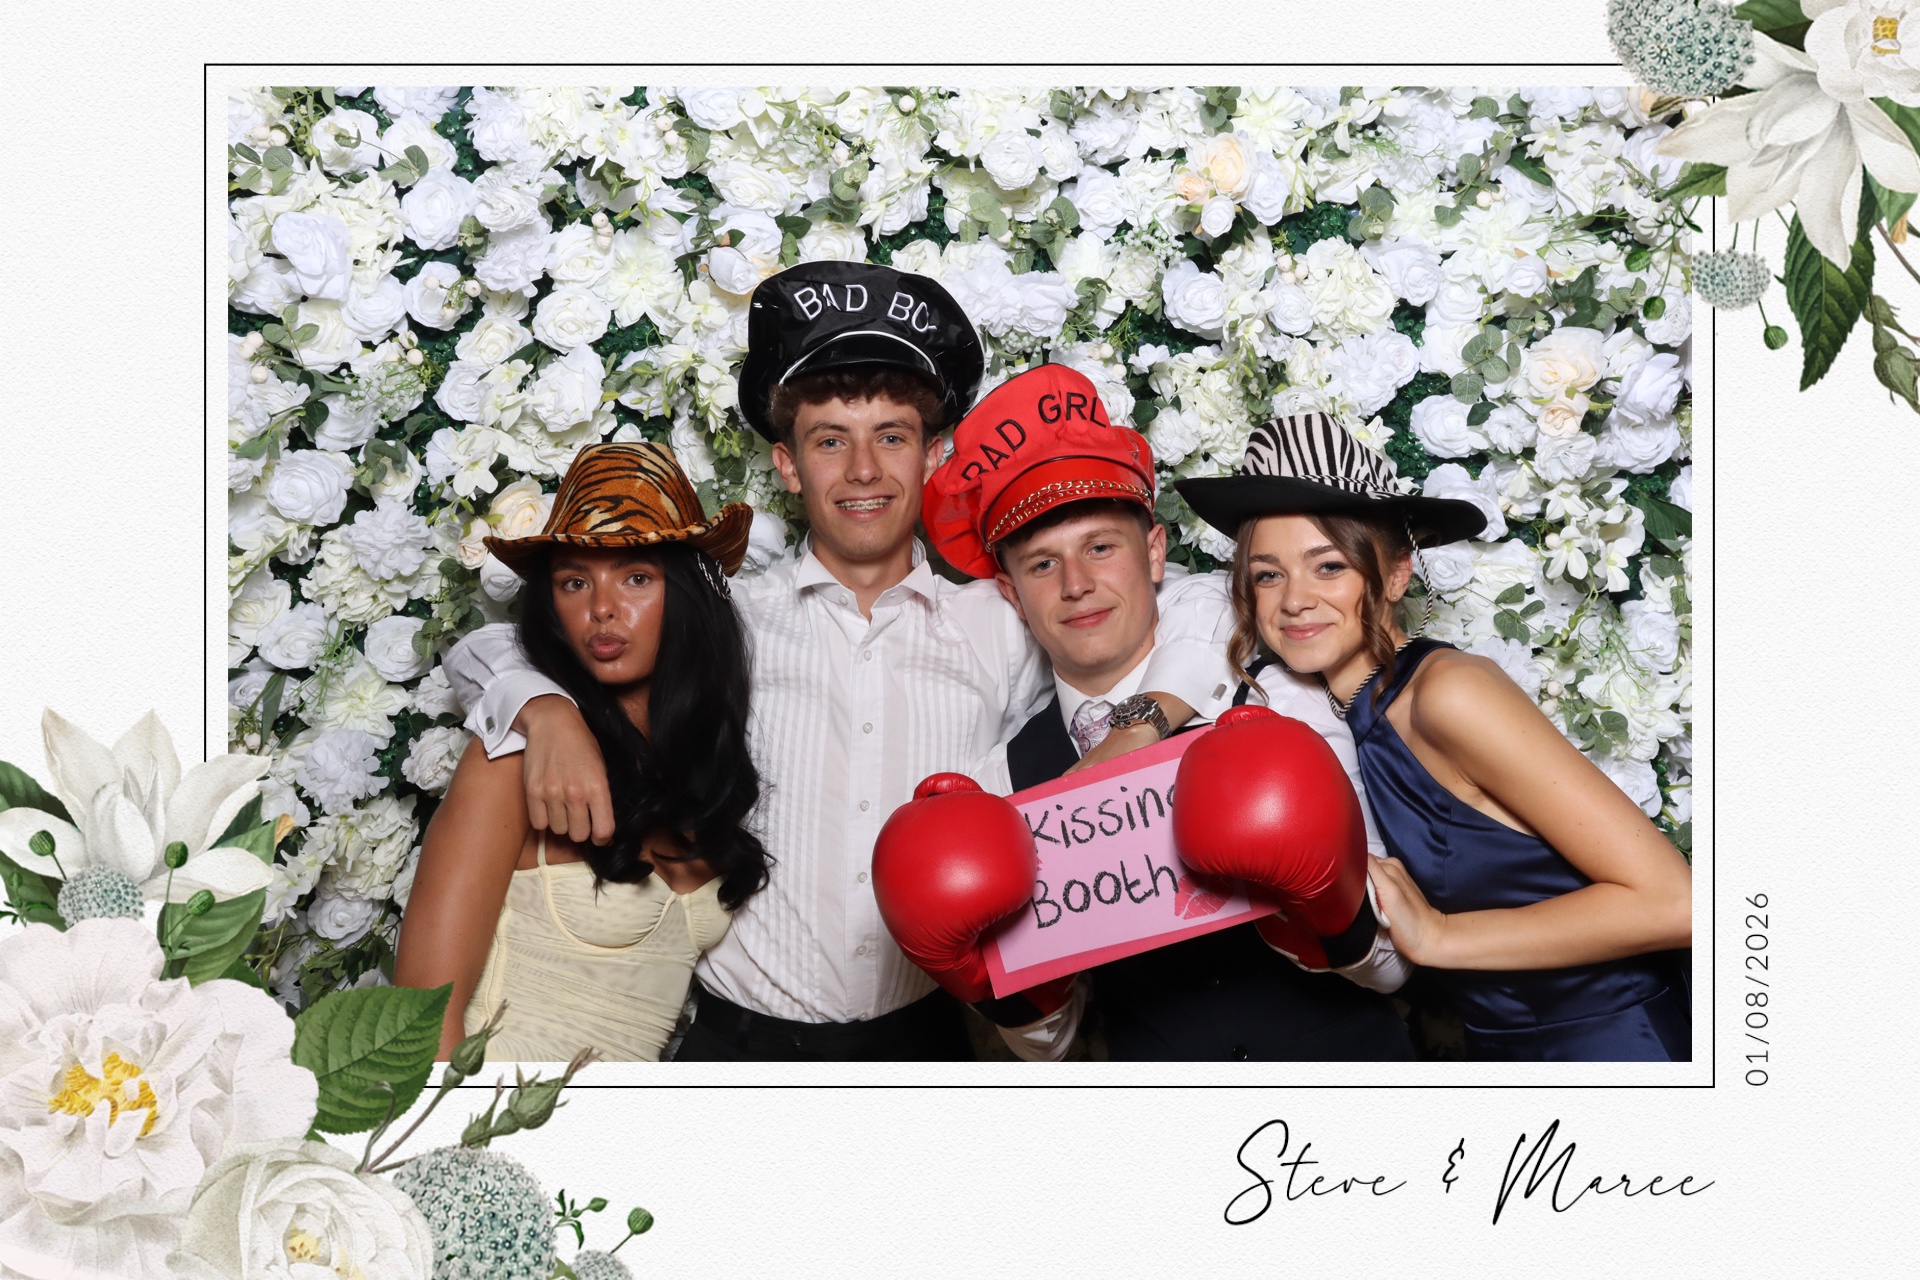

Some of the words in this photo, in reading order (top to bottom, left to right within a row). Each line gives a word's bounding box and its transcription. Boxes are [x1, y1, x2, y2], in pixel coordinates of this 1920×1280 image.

[794, 283, 868, 320] BAD
[887, 291, 938, 333] BO
[1038, 390, 1107, 428] GRL
[1031, 854, 1179, 929] Booth
